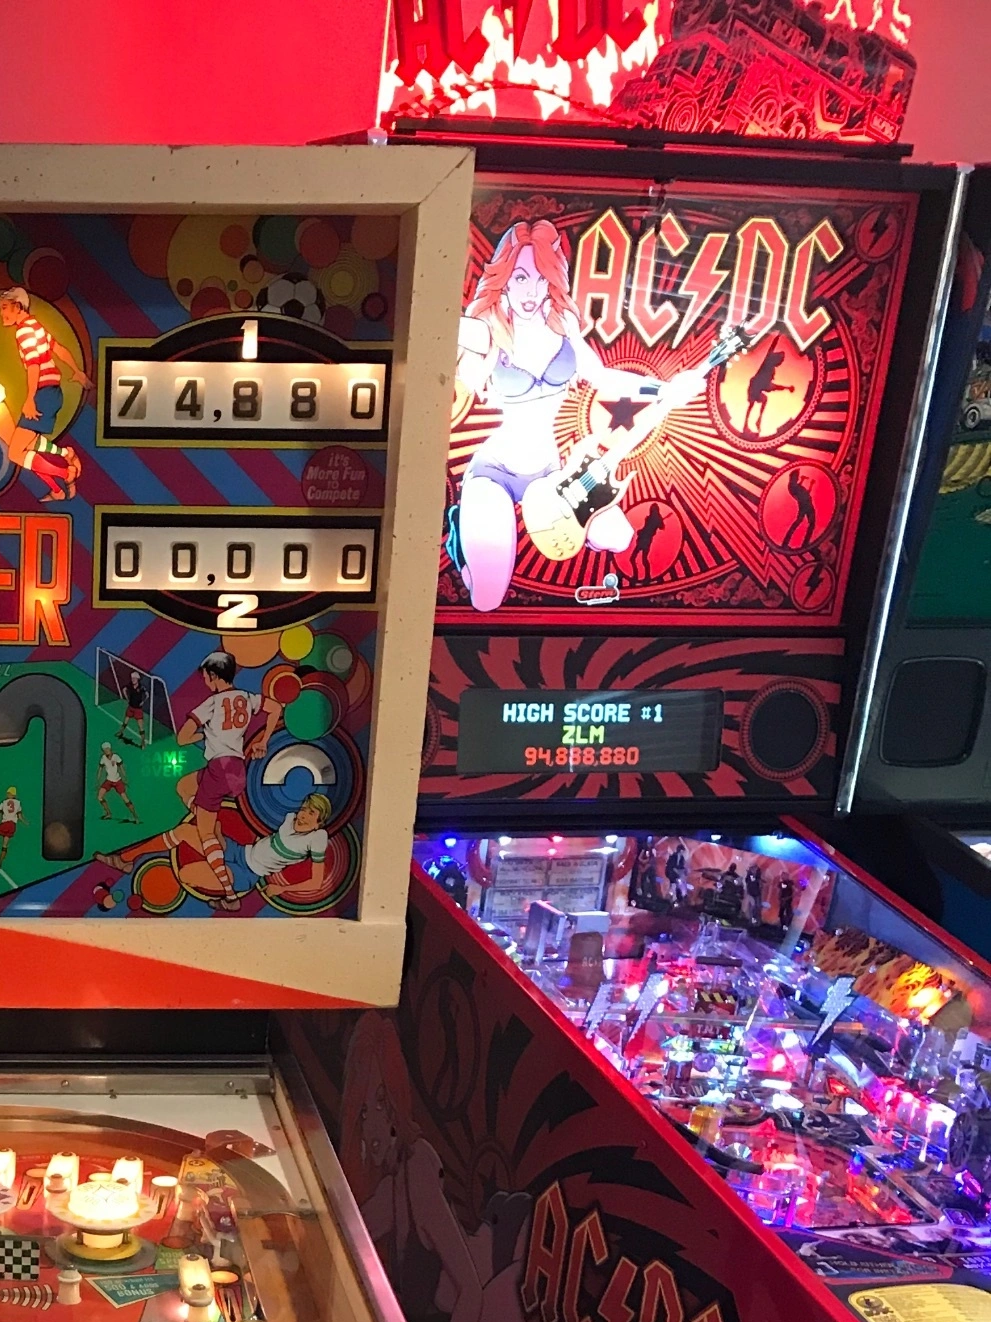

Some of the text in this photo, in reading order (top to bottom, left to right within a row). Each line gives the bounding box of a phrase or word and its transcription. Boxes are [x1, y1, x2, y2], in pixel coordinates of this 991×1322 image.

[240, 319, 259, 360] 1
[328, 452, 350, 467] it's
[306, 466, 366, 480] More Fun
[307, 485, 361, 503] Compete
[217, 593, 259, 629] 2
[221, 695, 249, 730] 18
[503, 703, 663, 723] HIGH SCORE #1
[562, 725, 605, 744] ZLM
[117, 1289, 155, 1297] BONUS
